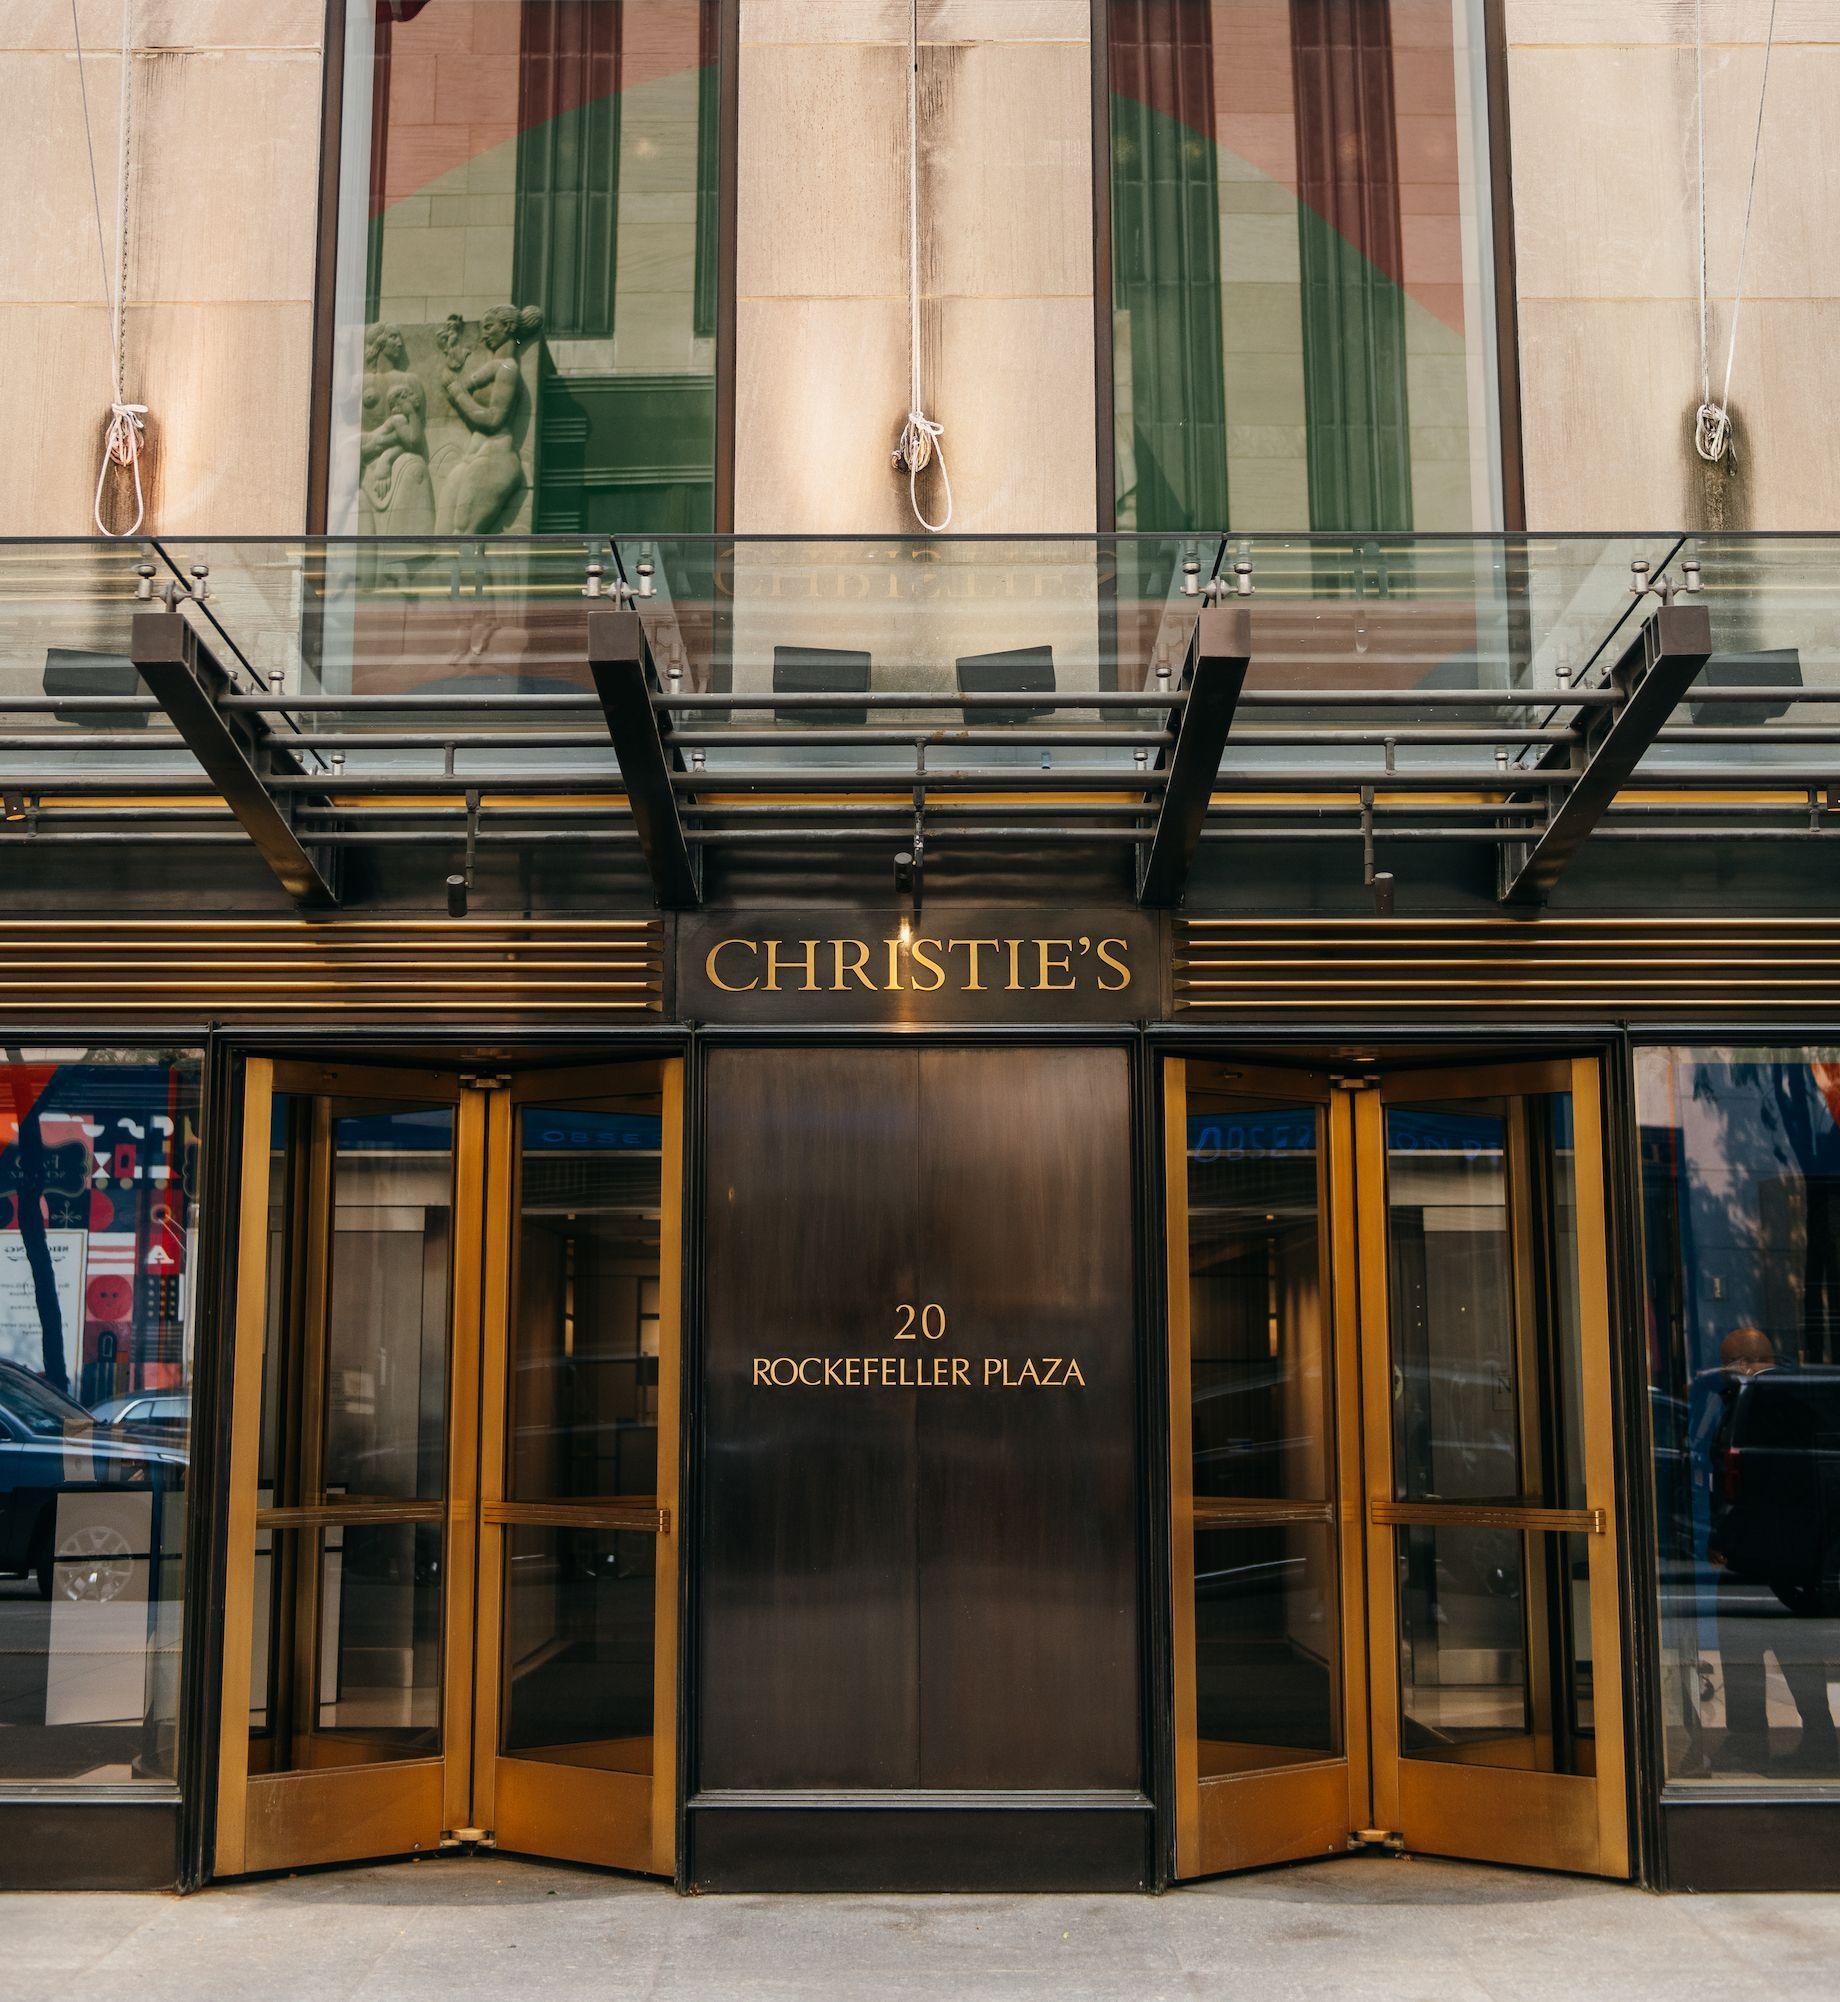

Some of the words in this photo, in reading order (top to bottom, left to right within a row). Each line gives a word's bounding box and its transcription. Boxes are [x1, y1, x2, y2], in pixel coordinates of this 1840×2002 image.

[705, 936, 1131, 992] CHRISTIE'S
[893, 1303, 947, 1341] 20
[753, 1357, 971, 1386] ROCKEFELLER
[984, 1357, 1086, 1386] PLAZA
